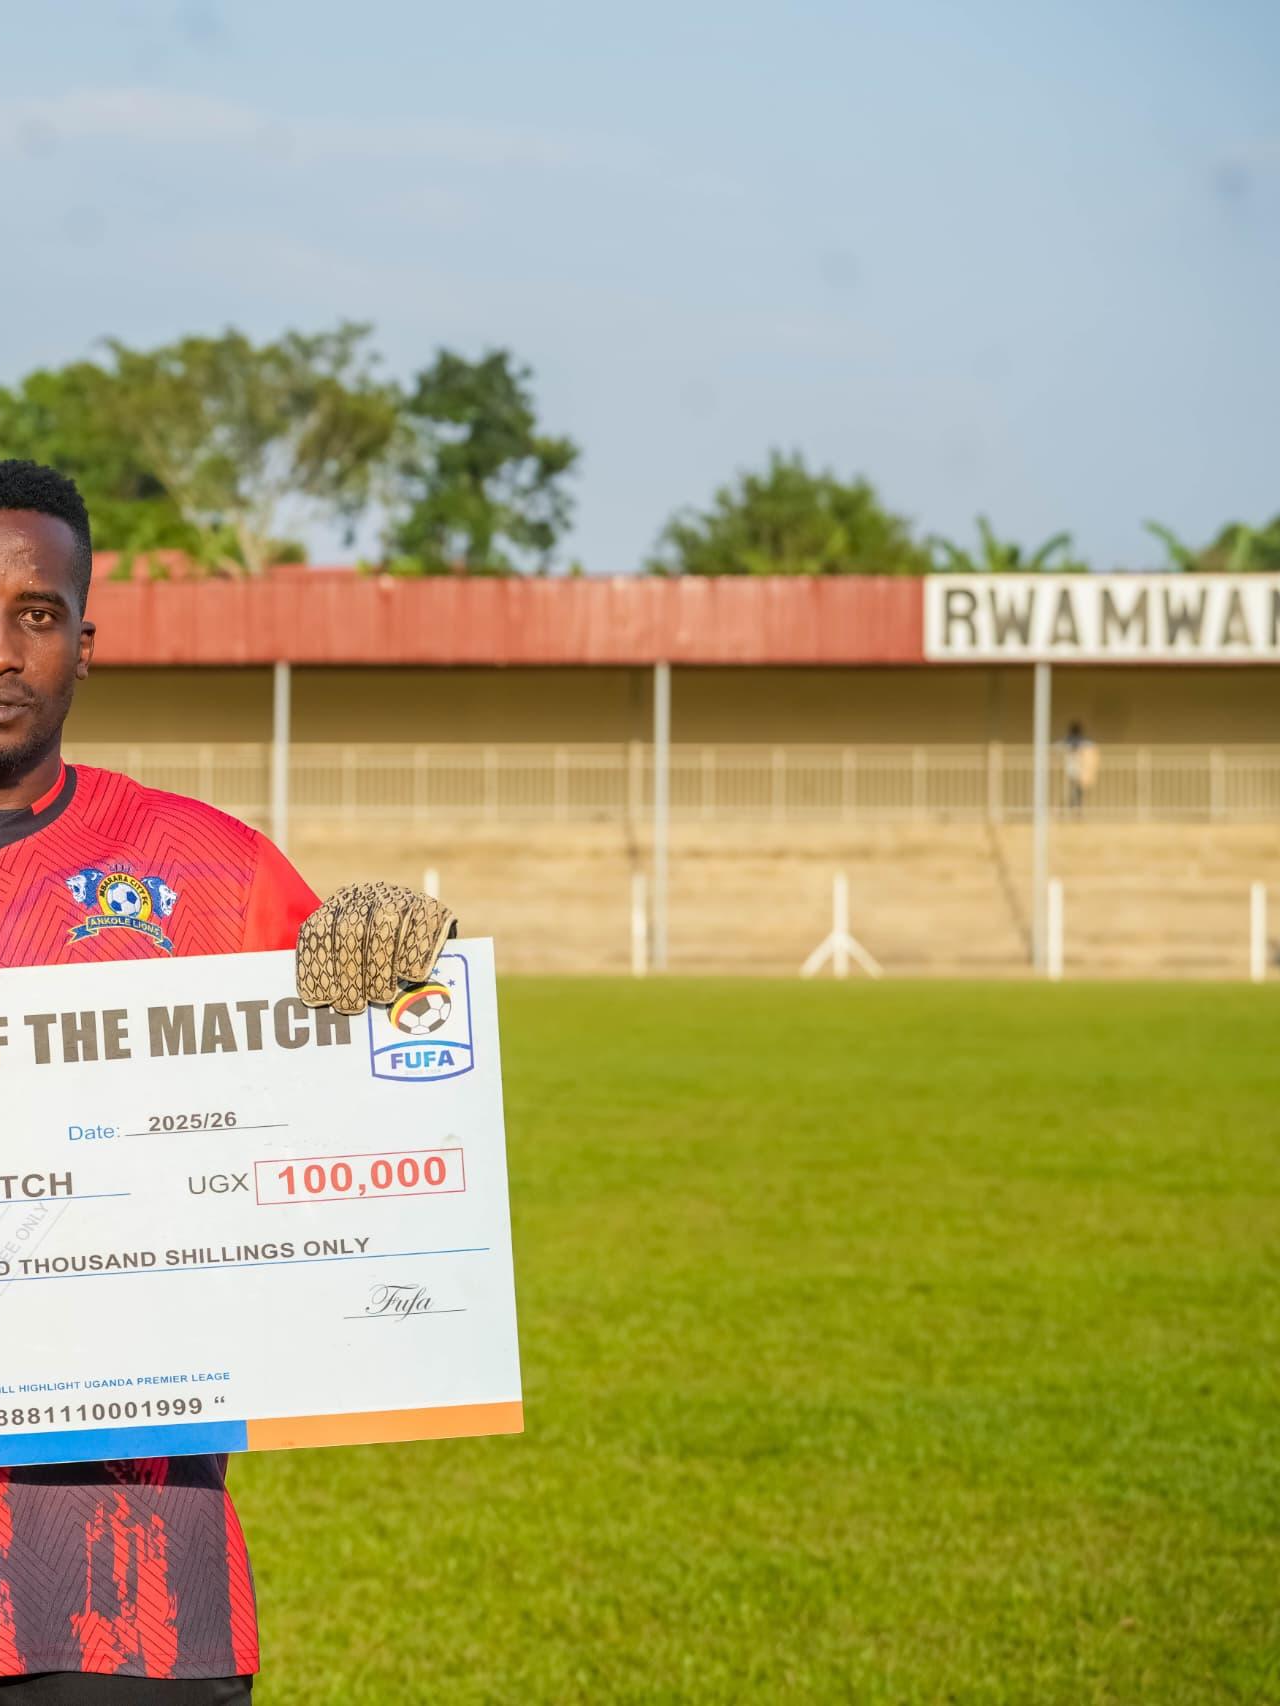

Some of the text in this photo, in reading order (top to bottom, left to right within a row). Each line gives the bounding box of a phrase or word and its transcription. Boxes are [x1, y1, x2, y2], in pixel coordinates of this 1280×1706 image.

[943, 588, 1280, 646] RWAMWA
[130, 879, 146, 895] CITY
[141, 895, 149, 906] FC
[91, 917, 161, 935] ANKOLE LIONS
[24, 1008, 132, 1065] THE
[147, 997, 352, 1057] MATCH
[390, 1049, 456, 1069] FUFA
[68, 1111, 237, 1141] Date: 2025/26
[187, 1156, 447, 1196] UGX 100,000
[15, 1202, 48, 1241] ONLY
[19, 1251, 156, 1275] THOUSAND
[165, 1242, 295, 1266] SHILLINGS
[303, 1237, 371, 1257] ONLY
[365, 1283, 433, 1322] Fufa
[19, 1381, 81, 1393] HIGHLIGHT
[84, 1378, 133, 1389] UGANDA
[137, 1375, 188, 1386] PREMIER
[192, 1372, 231, 1382] LEAGE
